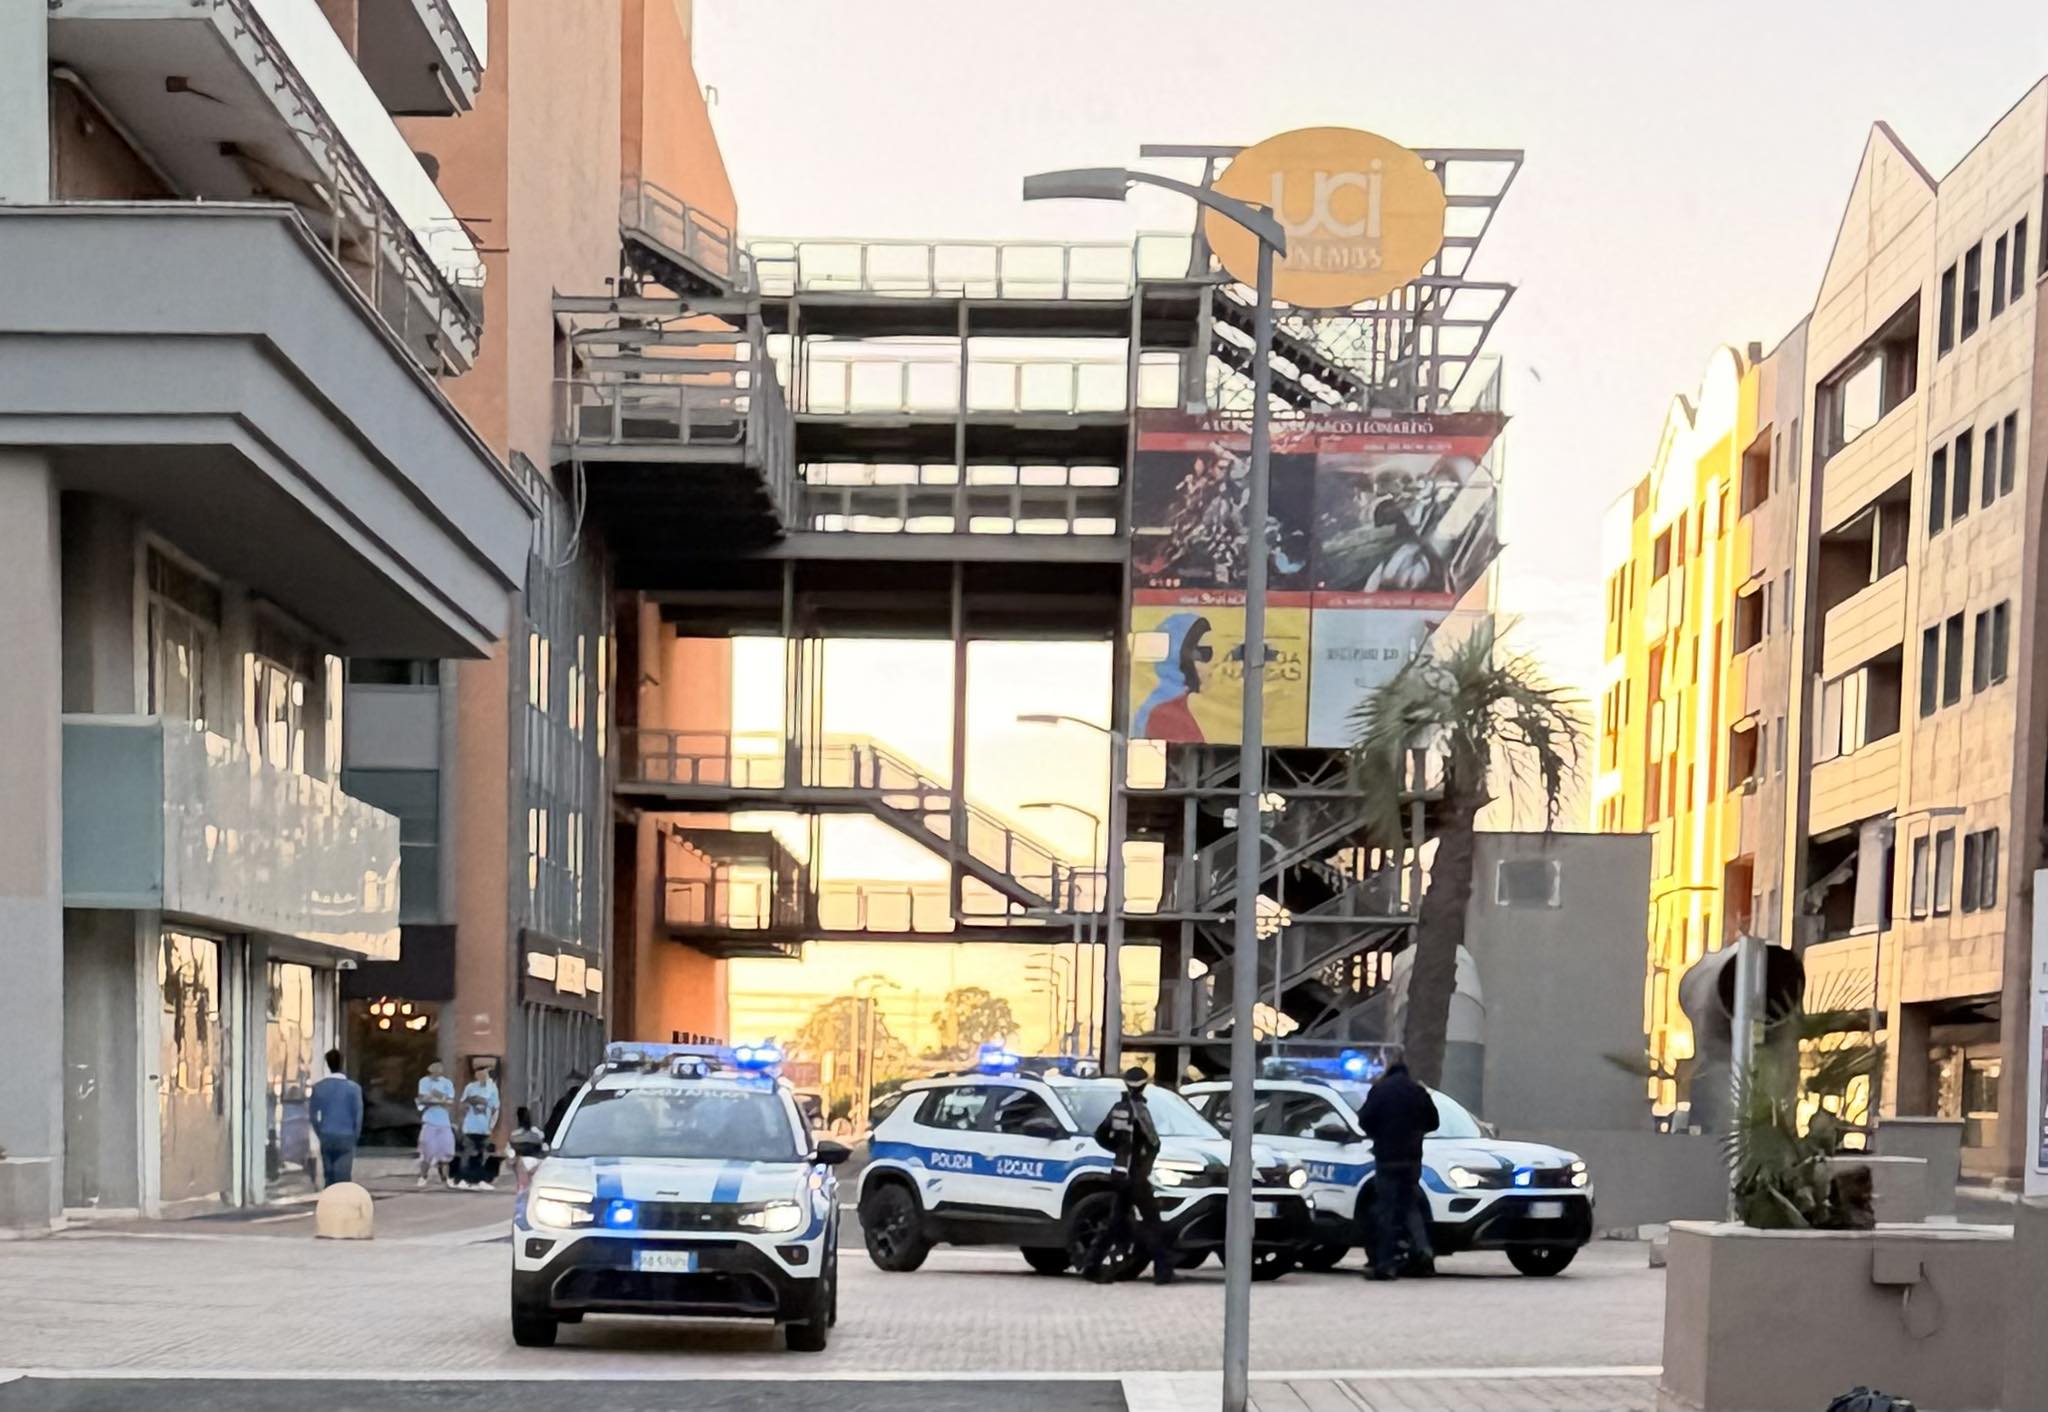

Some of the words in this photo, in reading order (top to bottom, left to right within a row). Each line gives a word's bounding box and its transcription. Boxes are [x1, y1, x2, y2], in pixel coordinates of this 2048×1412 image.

[1270, 159, 1382, 239] uci
[930, 1151, 974, 1169] POLIZIA
[996, 1159, 1045, 1177] LOCALE
